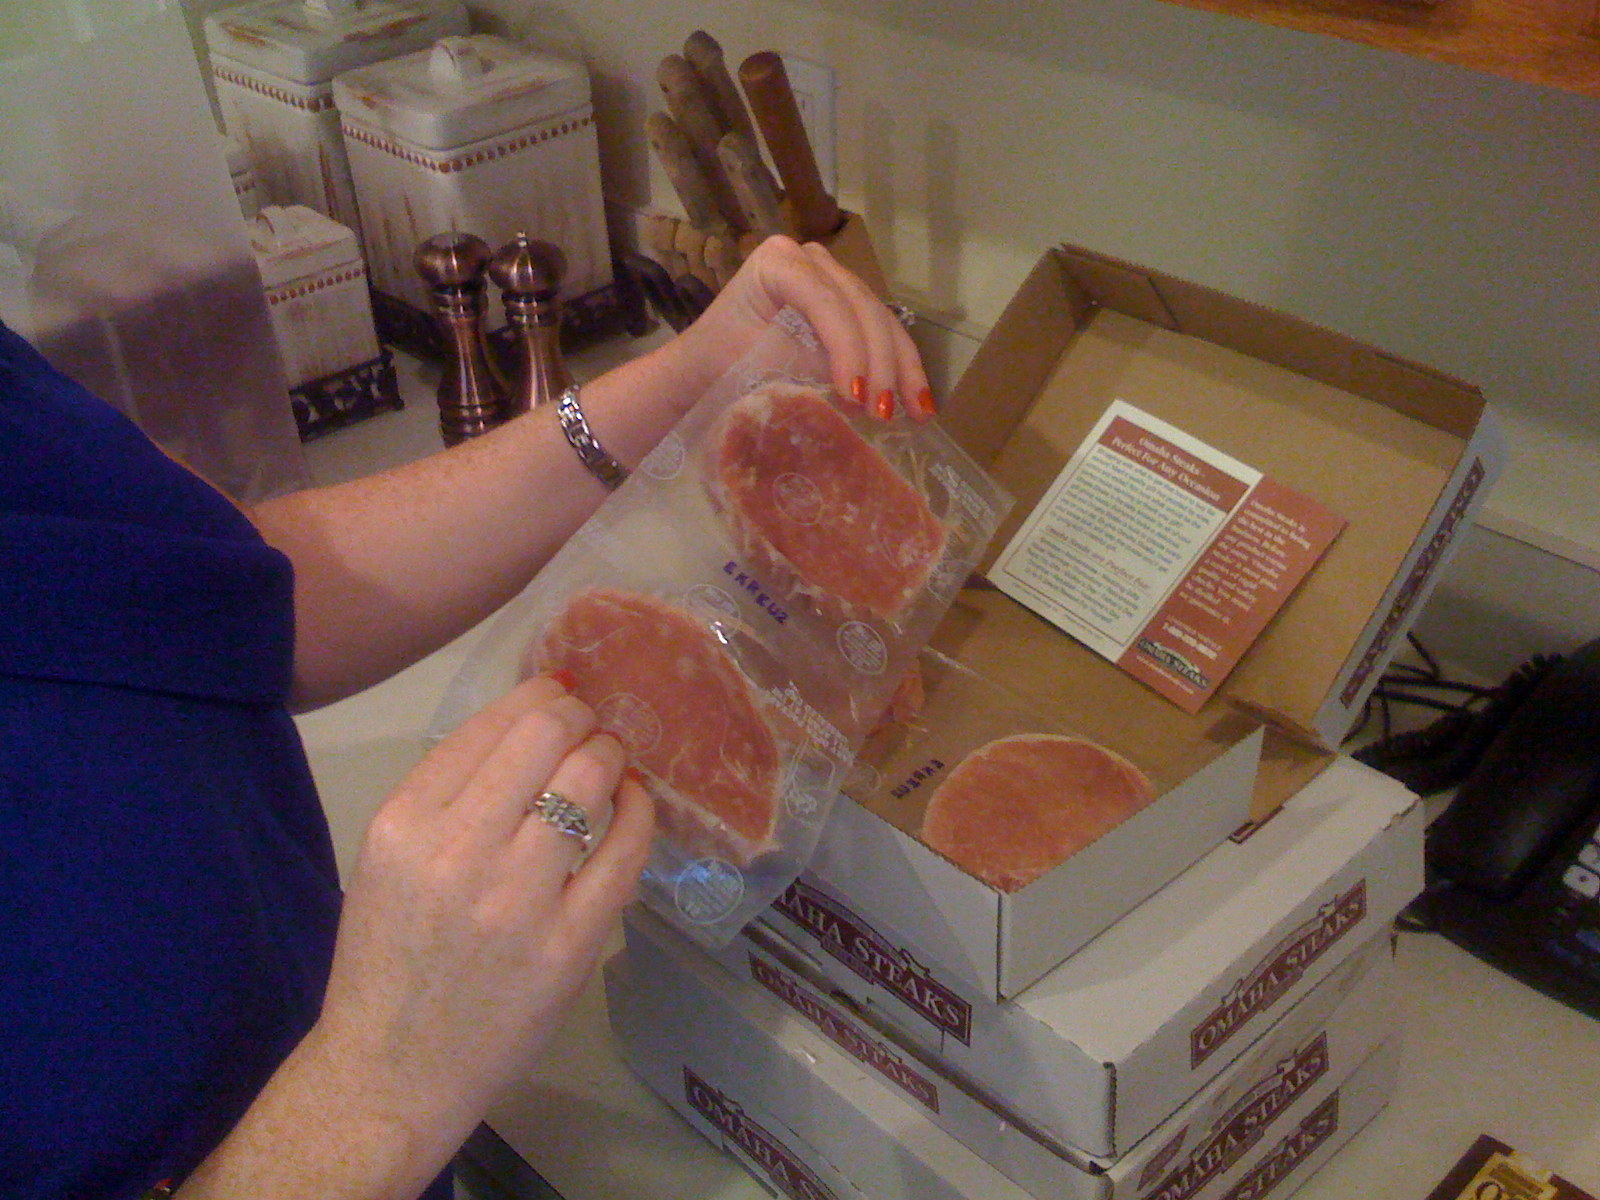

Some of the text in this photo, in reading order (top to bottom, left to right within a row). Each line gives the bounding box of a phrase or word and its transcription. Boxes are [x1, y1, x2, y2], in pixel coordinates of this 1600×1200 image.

[1112, 437, 1221, 500] Perfect For Any Occasion
[853, 936, 960, 1027] STEAKS
[1199, 901, 1360, 1050] OMAHA STEAKS
[756, 965, 930, 1100] OMAHA STEAKS
[694, 1086, 790, 1184] OMAHA
[1244, 1056, 1323, 1137] STEAKS
